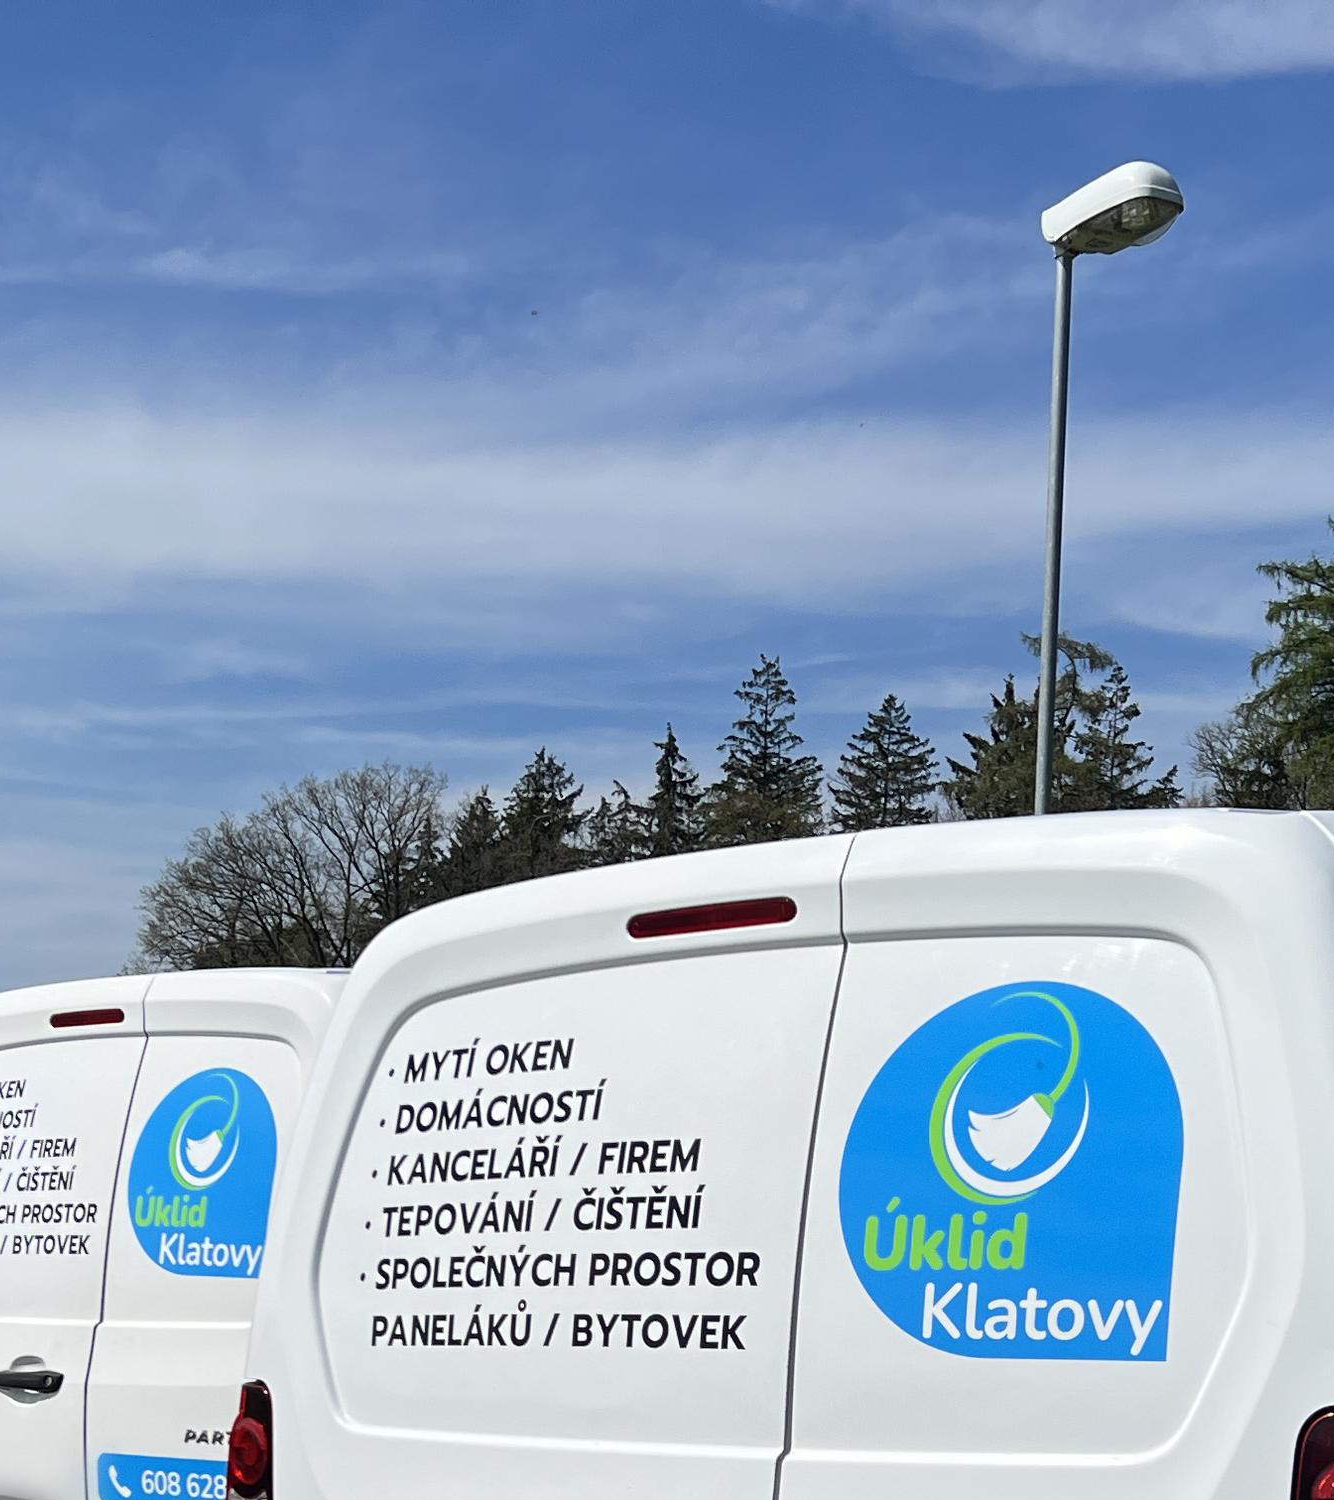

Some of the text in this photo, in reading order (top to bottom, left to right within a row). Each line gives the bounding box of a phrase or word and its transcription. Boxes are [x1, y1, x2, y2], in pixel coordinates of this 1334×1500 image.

[404, 1038, 575, 1085] MYTÍ OKEN
[395, 1078, 607, 1135] DOMÁCNOSTÍ
[30, 1138, 77, 1159] FIREM
[387, 1135, 563, 1187] KANCELÁŘÍ
[598, 1138, 701, 1175] FIREM
[17, 1165, 76, 1191] ČIŠTĚNÍ
[21, 1203, 97, 1224] PROSTOR
[135, 1187, 208, 1228] Úklid
[383, 1190, 537, 1237] TEPOVÁNÍ
[574, 1184, 706, 1231] ČIŠTĚNÍ
[12, 1235, 90, 1255] BYTOVEK
[159, 1232, 263, 1276] Klatovy
[864, 1196, 1028, 1271] Úklid
[375, 1244, 760, 1290] SPOLEČNÝCH PROSTOR
[371, 1299, 532, 1347] PANELÁKŮ
[572, 1314, 747, 1350] BYTOVEK
[922, 1281, 1163, 1356] Klatovy
[141, 1469, 227, 1500] 608 628
